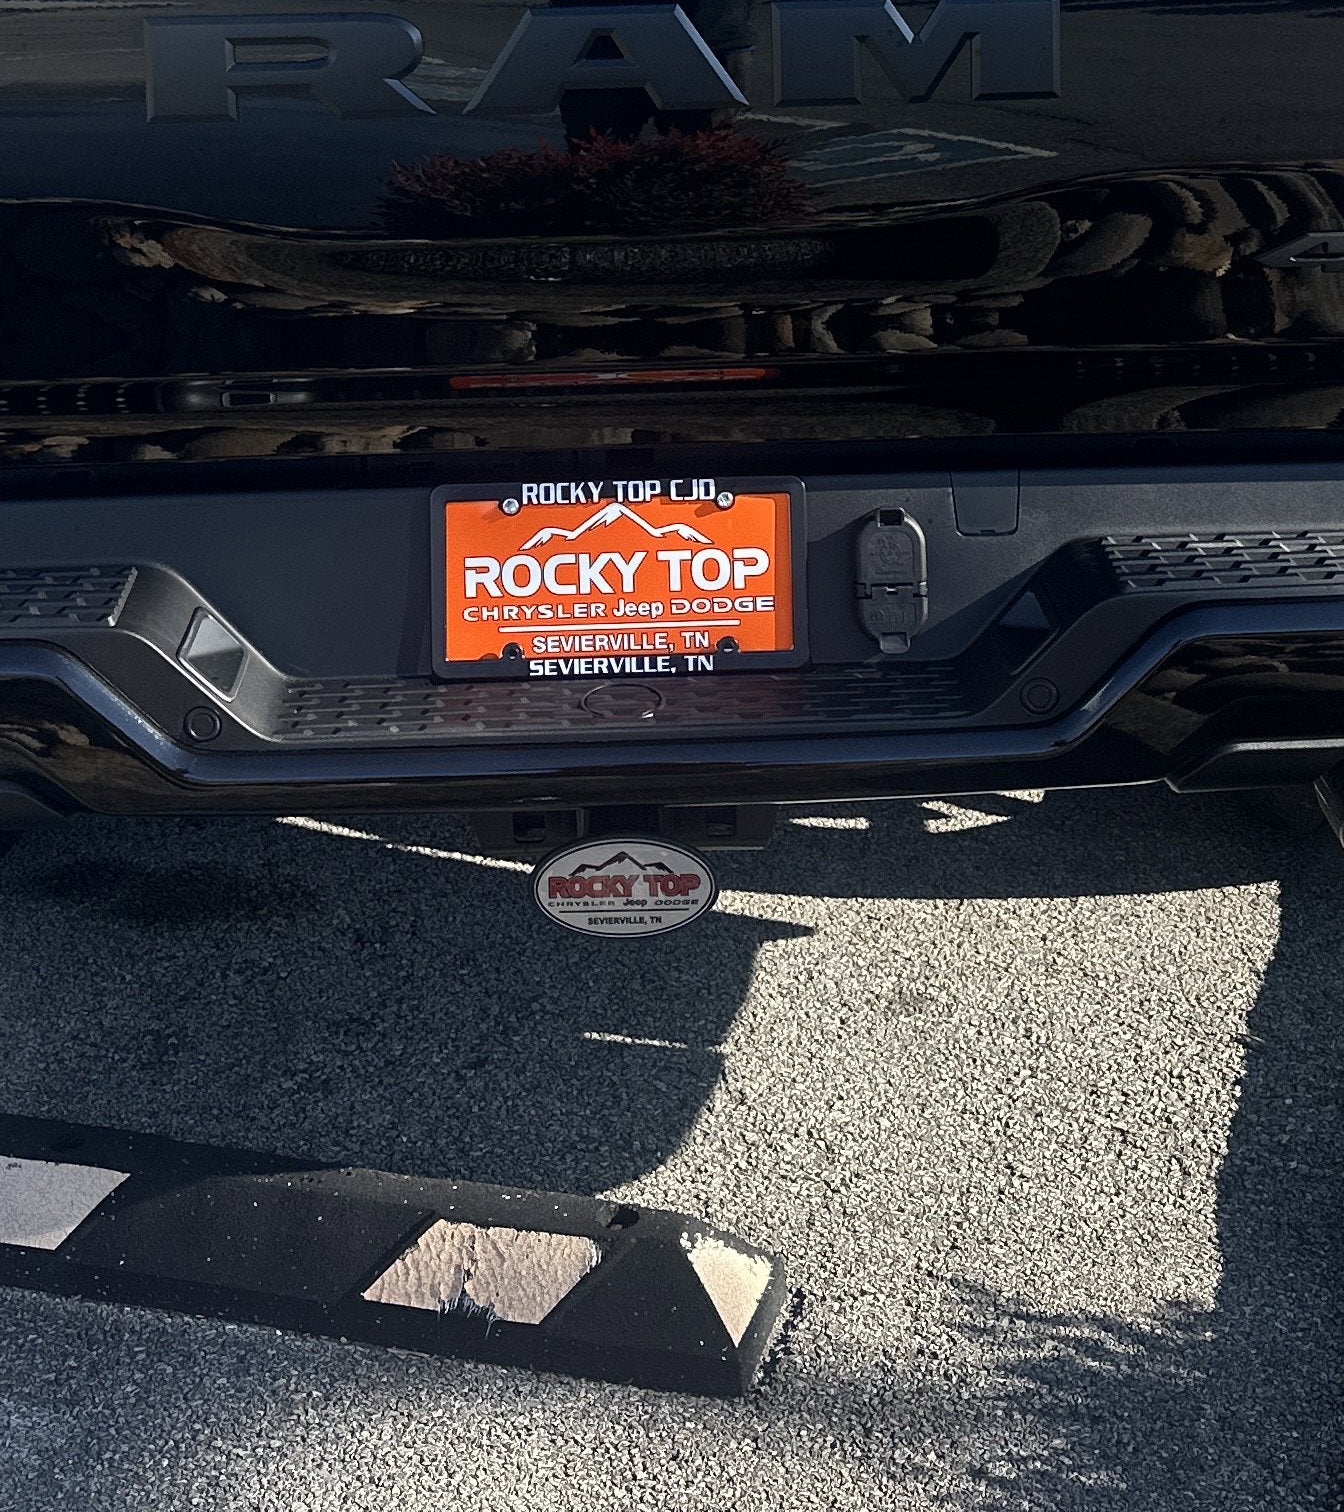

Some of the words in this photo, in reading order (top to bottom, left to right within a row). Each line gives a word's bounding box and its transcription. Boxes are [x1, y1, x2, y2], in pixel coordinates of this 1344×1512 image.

[522, 482, 603, 505] ROCKY
[613, 480, 661, 503] TOP
[670, 478, 716, 501] CJD
[463, 551, 648, 598] ROCKY
[657, 547, 770, 592] TOP
[463, 603, 606, 621] CHRYSLER
[613, 599, 663, 619] Jeep
[670, 595, 775, 615] DODGE
[532, 633, 674, 654] SEVIERVILLE,
[684, 631, 709, 649] TN
[529, 656, 676, 677] SEVIERVILLE,
[684, 654, 714, 672] TN
[548, 875, 640, 899] ROCKY
[643, 873, 701, 897] TOP
[623, 898, 647, 907] Jeep
[649, 916, 662, 924] TN
